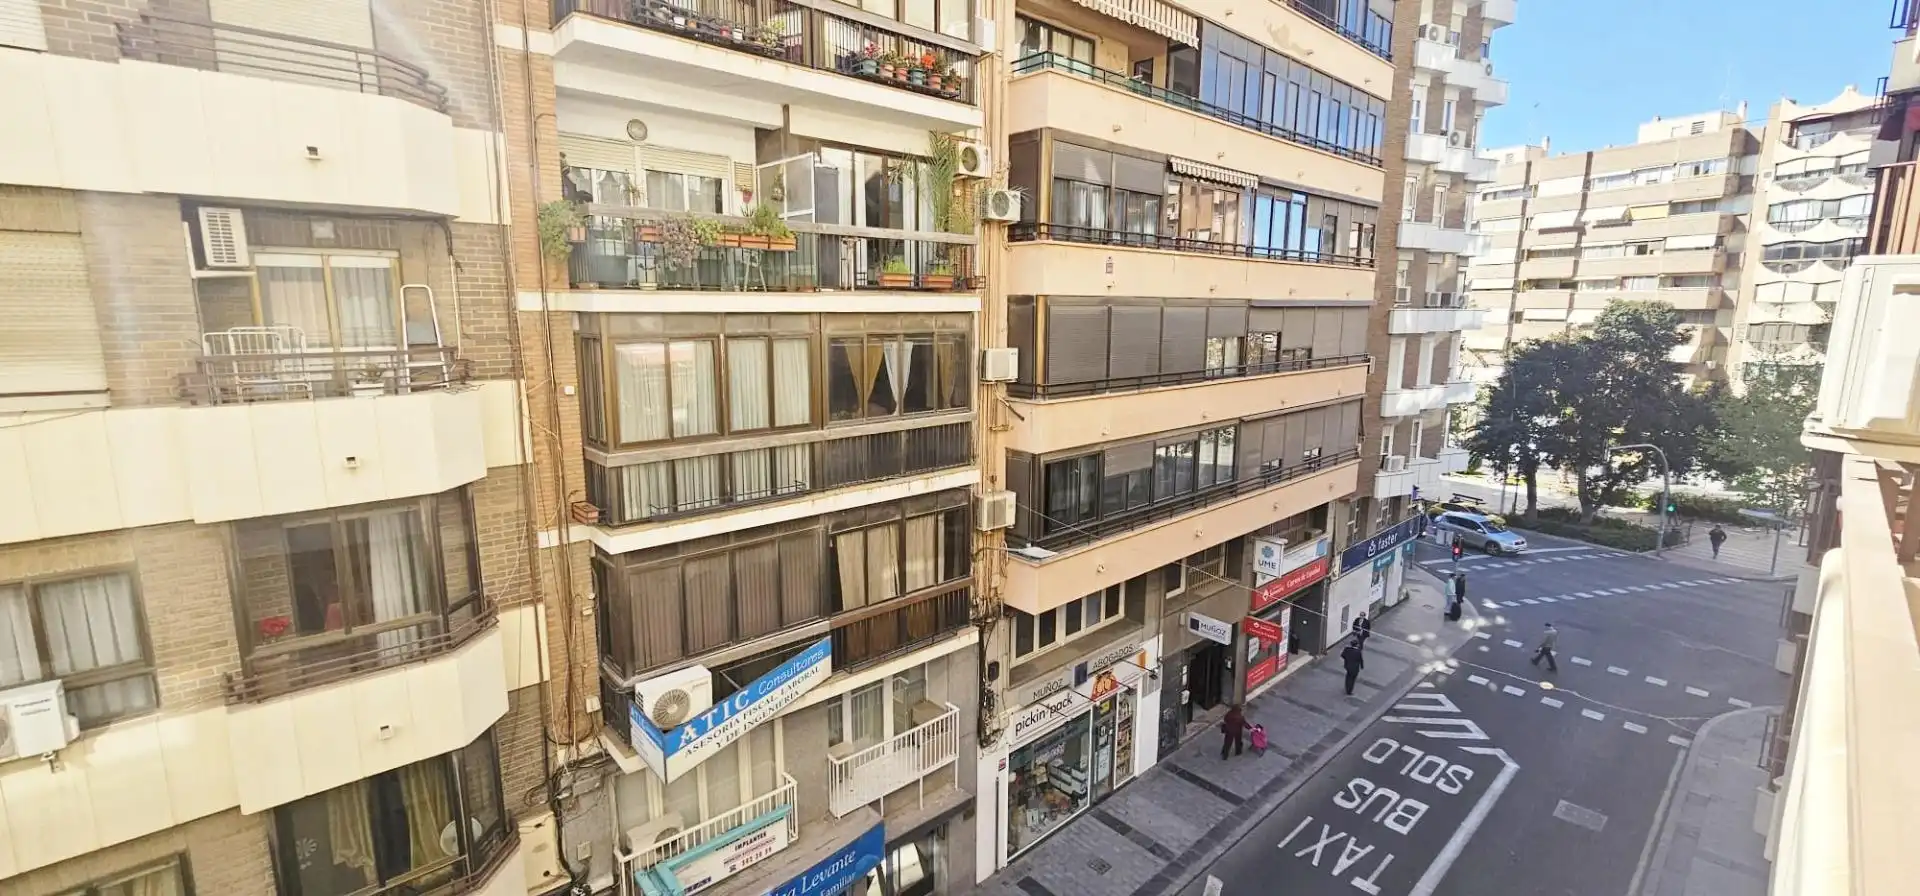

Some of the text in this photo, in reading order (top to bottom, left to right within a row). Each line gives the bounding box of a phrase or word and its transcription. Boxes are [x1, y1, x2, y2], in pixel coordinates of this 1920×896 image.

[1258, 559, 1277, 570] UME
[780, 664, 821, 697] LABORAL
[1033, 643, 1135, 700] MUÑOZ ABOGADOS
[679, 689, 750, 750] ATIC
[758, 649, 824, 695] Consultores
[715, 740, 724, 749] Y
[725, 730, 740, 743] DE
[1361, 737, 1474, 795] SOLO
[1332, 777, 1430, 835] BUS
[735, 831, 767, 852] IMPLANTES
[1277, 815, 1395, 896] TAXI
[801, 850, 856, 894] Levante
[820, 871, 856, 896] Familiar
